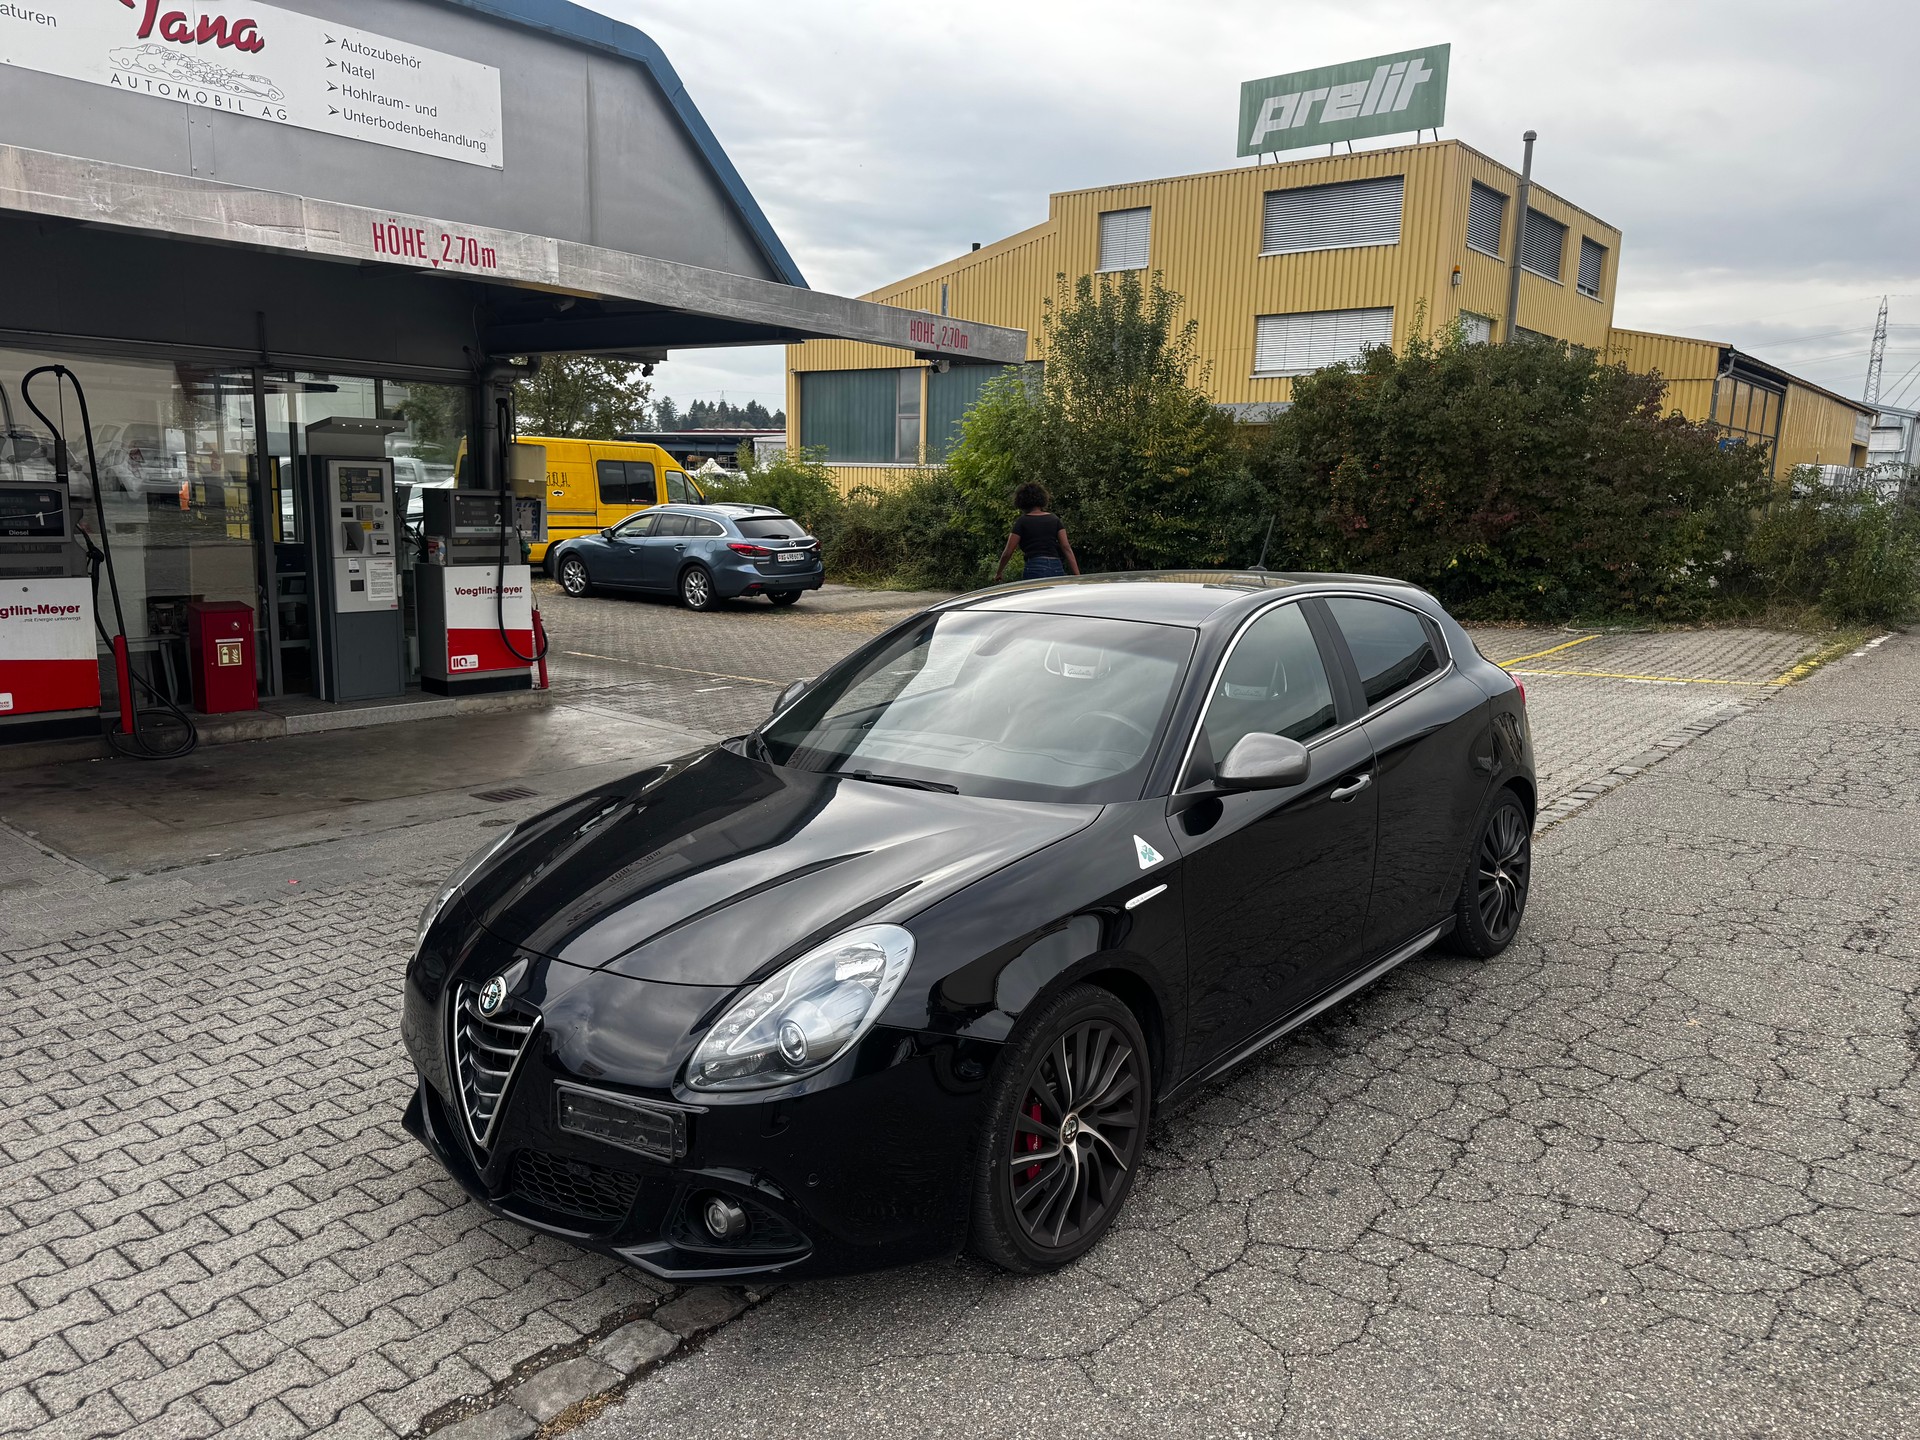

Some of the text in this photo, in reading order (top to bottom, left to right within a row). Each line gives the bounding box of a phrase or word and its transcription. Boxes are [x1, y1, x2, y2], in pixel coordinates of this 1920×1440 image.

[340, 38, 422, 69] Autozubehör
[341, 61, 375, 80] Natel
[110, 73, 288, 120] AUTOMOBIL AG
[342, 84, 437, 117] Hohlraum- und
[1249, 58, 1433, 146] prelit
[343, 108, 487, 153] Unterbodenbehandlung
[372, 218, 428, 259] HÖHE
[35, 511, 45, 526] 1
[493, 513, 502, 525] 2
